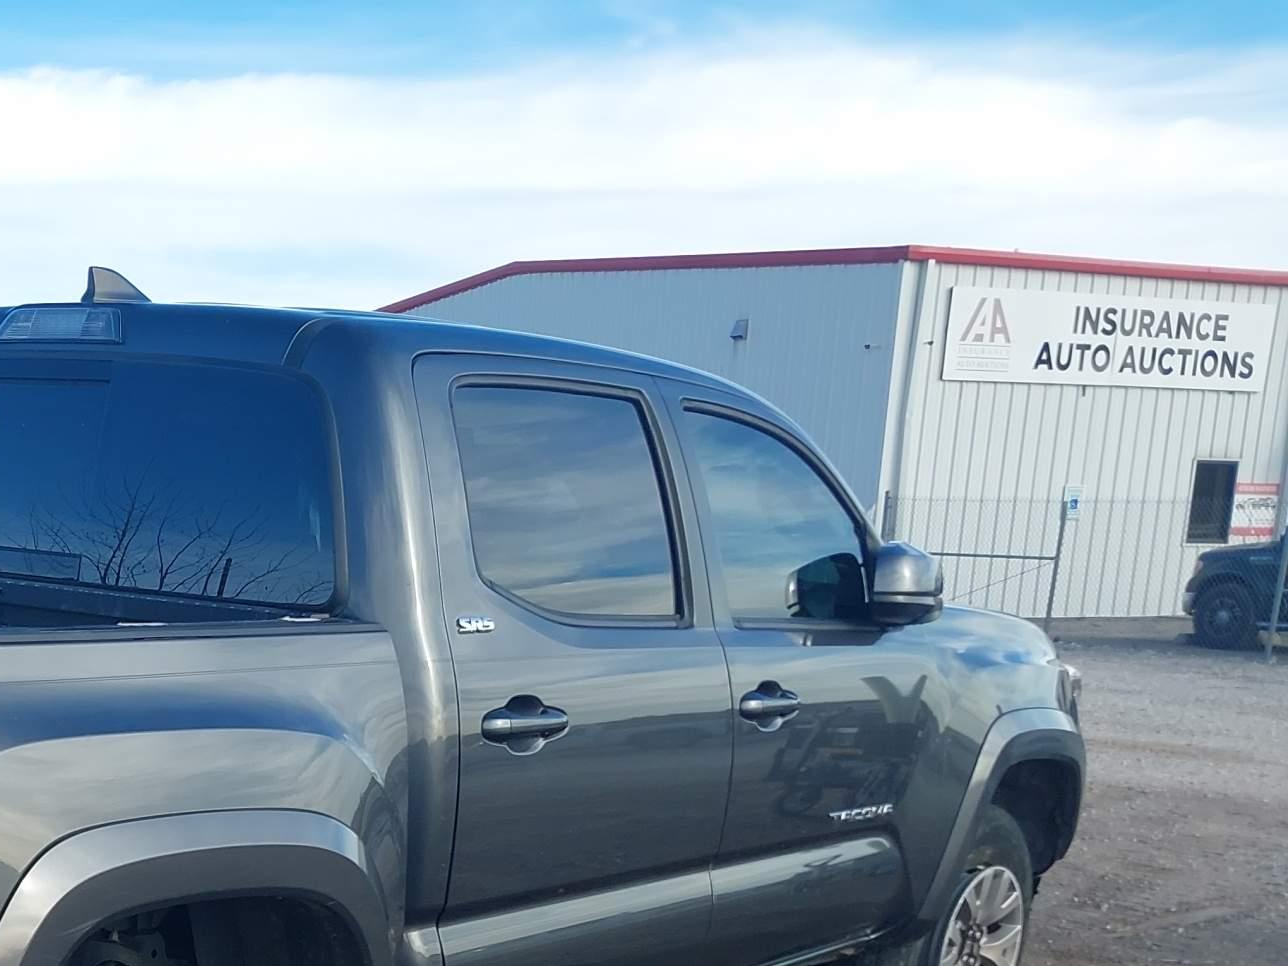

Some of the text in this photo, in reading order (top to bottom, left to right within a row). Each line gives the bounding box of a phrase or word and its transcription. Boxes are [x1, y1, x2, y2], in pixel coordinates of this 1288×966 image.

[1073, 305, 1230, 342] INSURANCE
[1033, 341, 1255, 380] AUTO AUCTIONS
[456, 616, 496, 635] SR5
